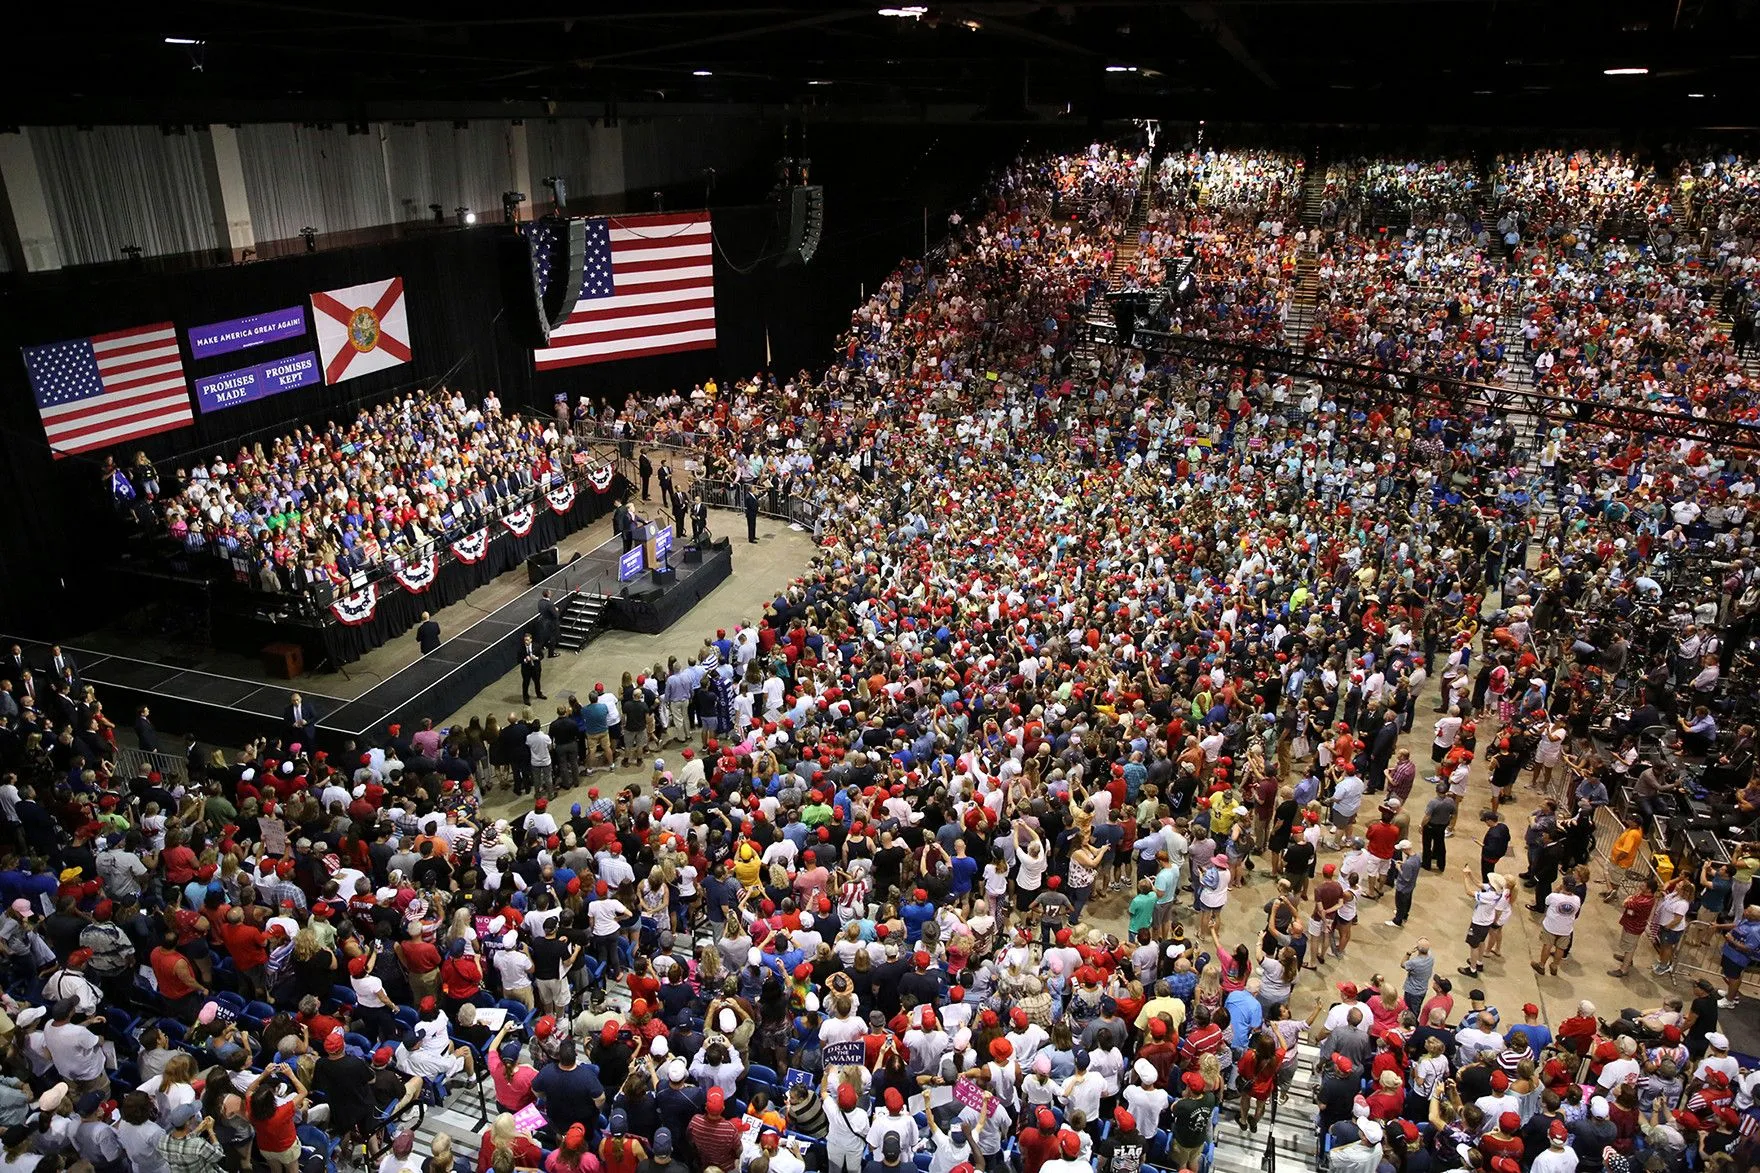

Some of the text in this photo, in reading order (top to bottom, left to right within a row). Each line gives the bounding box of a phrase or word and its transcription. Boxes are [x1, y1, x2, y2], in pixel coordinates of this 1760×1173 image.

[196, 318, 301, 347] MAKE AMERICA GREAT AGAIN!
[265, 359, 313, 379] PROMISES
[202, 374, 255, 395] PROMISES
[278, 371, 303, 386] KEPT
[216, 387, 247, 403] MADE
[352, 901, 374, 909] TRUMP
[1045, 904, 1060, 917] 17
[217, 1006, 235, 1018] UMP
[827, 1043, 860, 1054] DRAIN
[824, 1055, 862, 1065] SWAMP
[960, 1077, 1000, 1105] WOMN
[1113, 1146, 1143, 1158] FLAG
